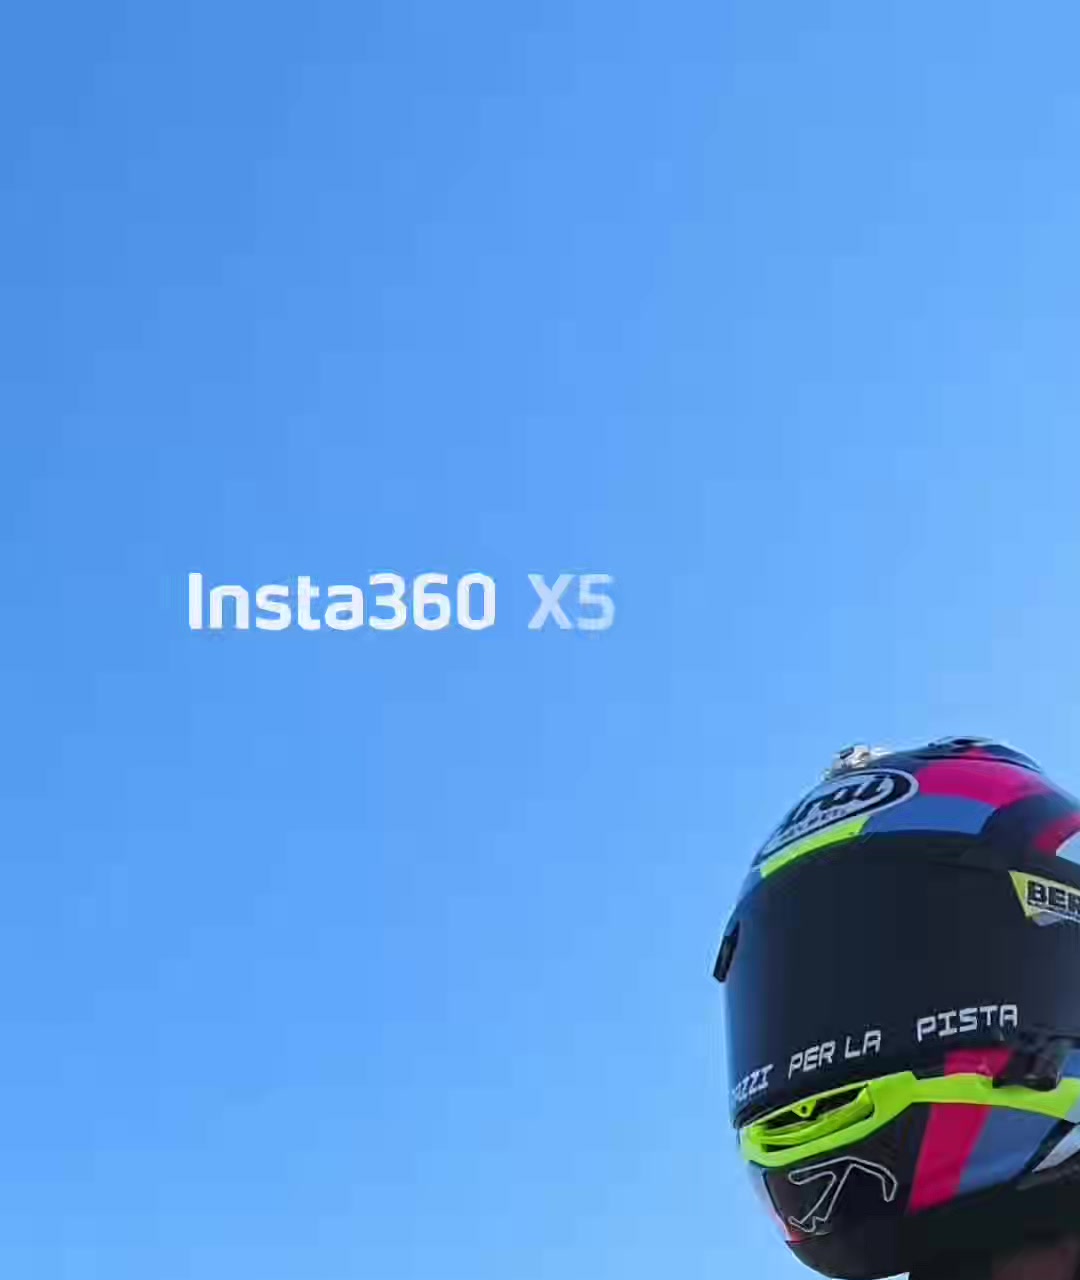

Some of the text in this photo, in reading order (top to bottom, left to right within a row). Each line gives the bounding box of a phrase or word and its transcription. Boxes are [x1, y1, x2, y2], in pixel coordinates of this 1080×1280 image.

[788, 1040, 836, 1079] PER
[845, 1029, 882, 1059] LA
[916, 1004, 1018, 1042] PISTA
